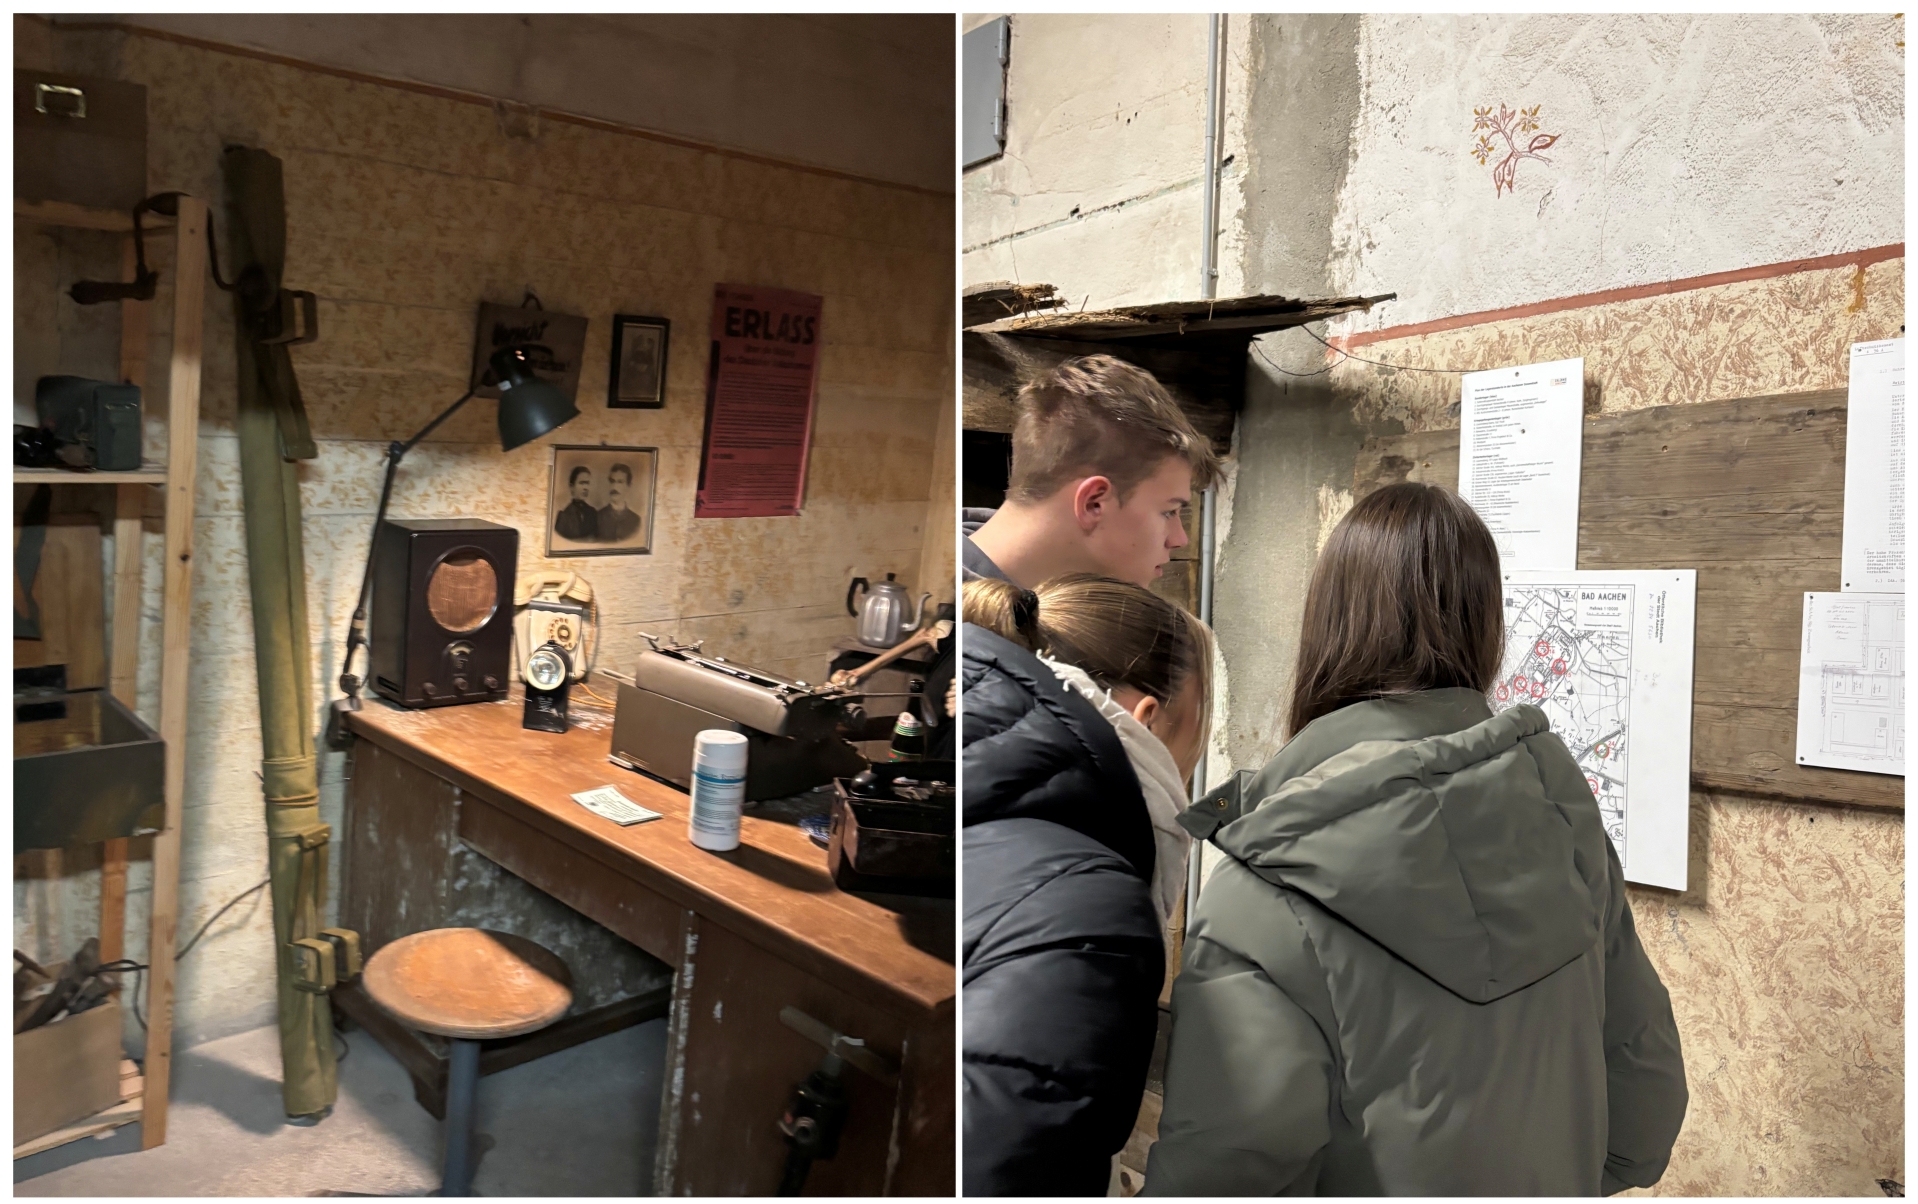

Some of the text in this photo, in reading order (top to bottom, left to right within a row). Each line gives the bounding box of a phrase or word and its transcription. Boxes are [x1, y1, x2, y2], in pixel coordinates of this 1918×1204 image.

[725, 306, 816, 345] ERLASS
[1582, 592, 1626, 600] BAD AACHEN
